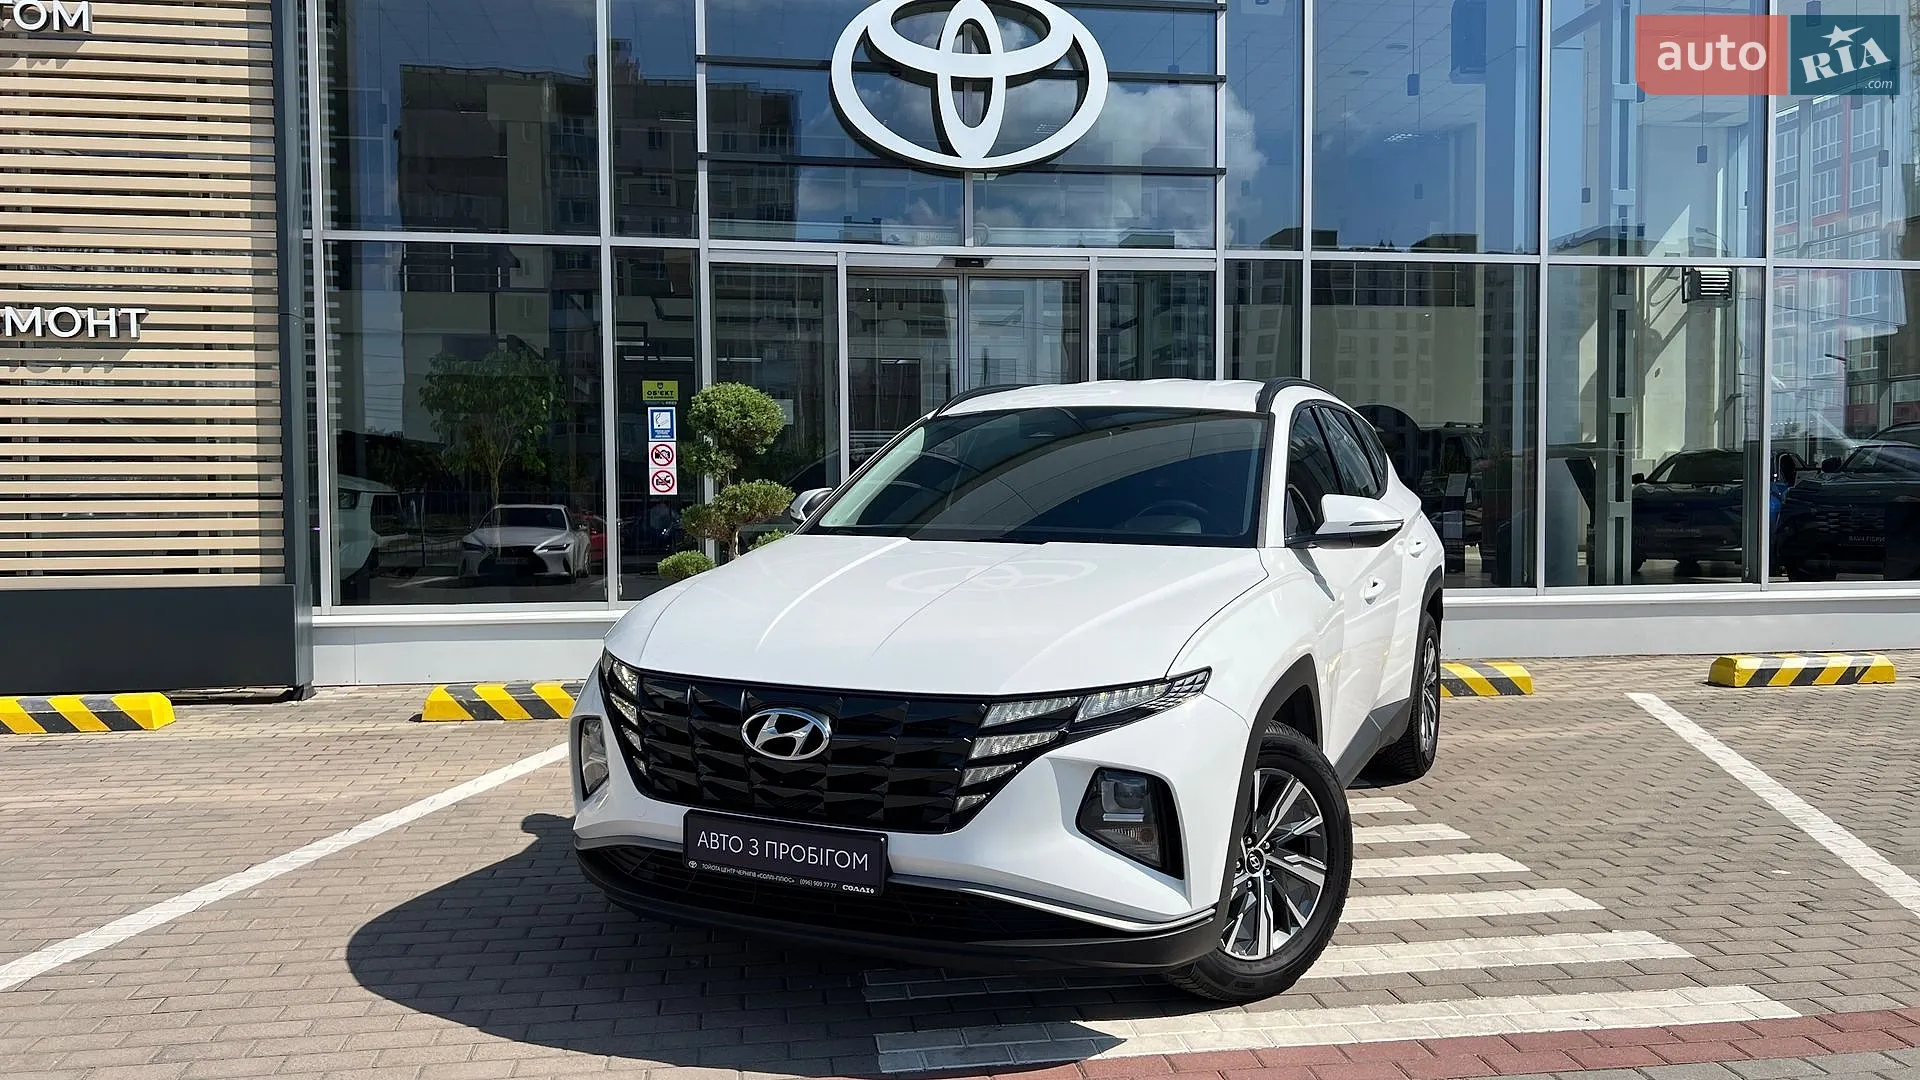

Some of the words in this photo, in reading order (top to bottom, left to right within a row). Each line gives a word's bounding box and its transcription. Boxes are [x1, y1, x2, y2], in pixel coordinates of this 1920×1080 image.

[697, 831, 743, 854] АВТО
[765, 840, 869, 872] ПРОБІГОМ
[702, 863, 720, 872] ТОЙОТА
[799, 878, 813, 887] (096)
